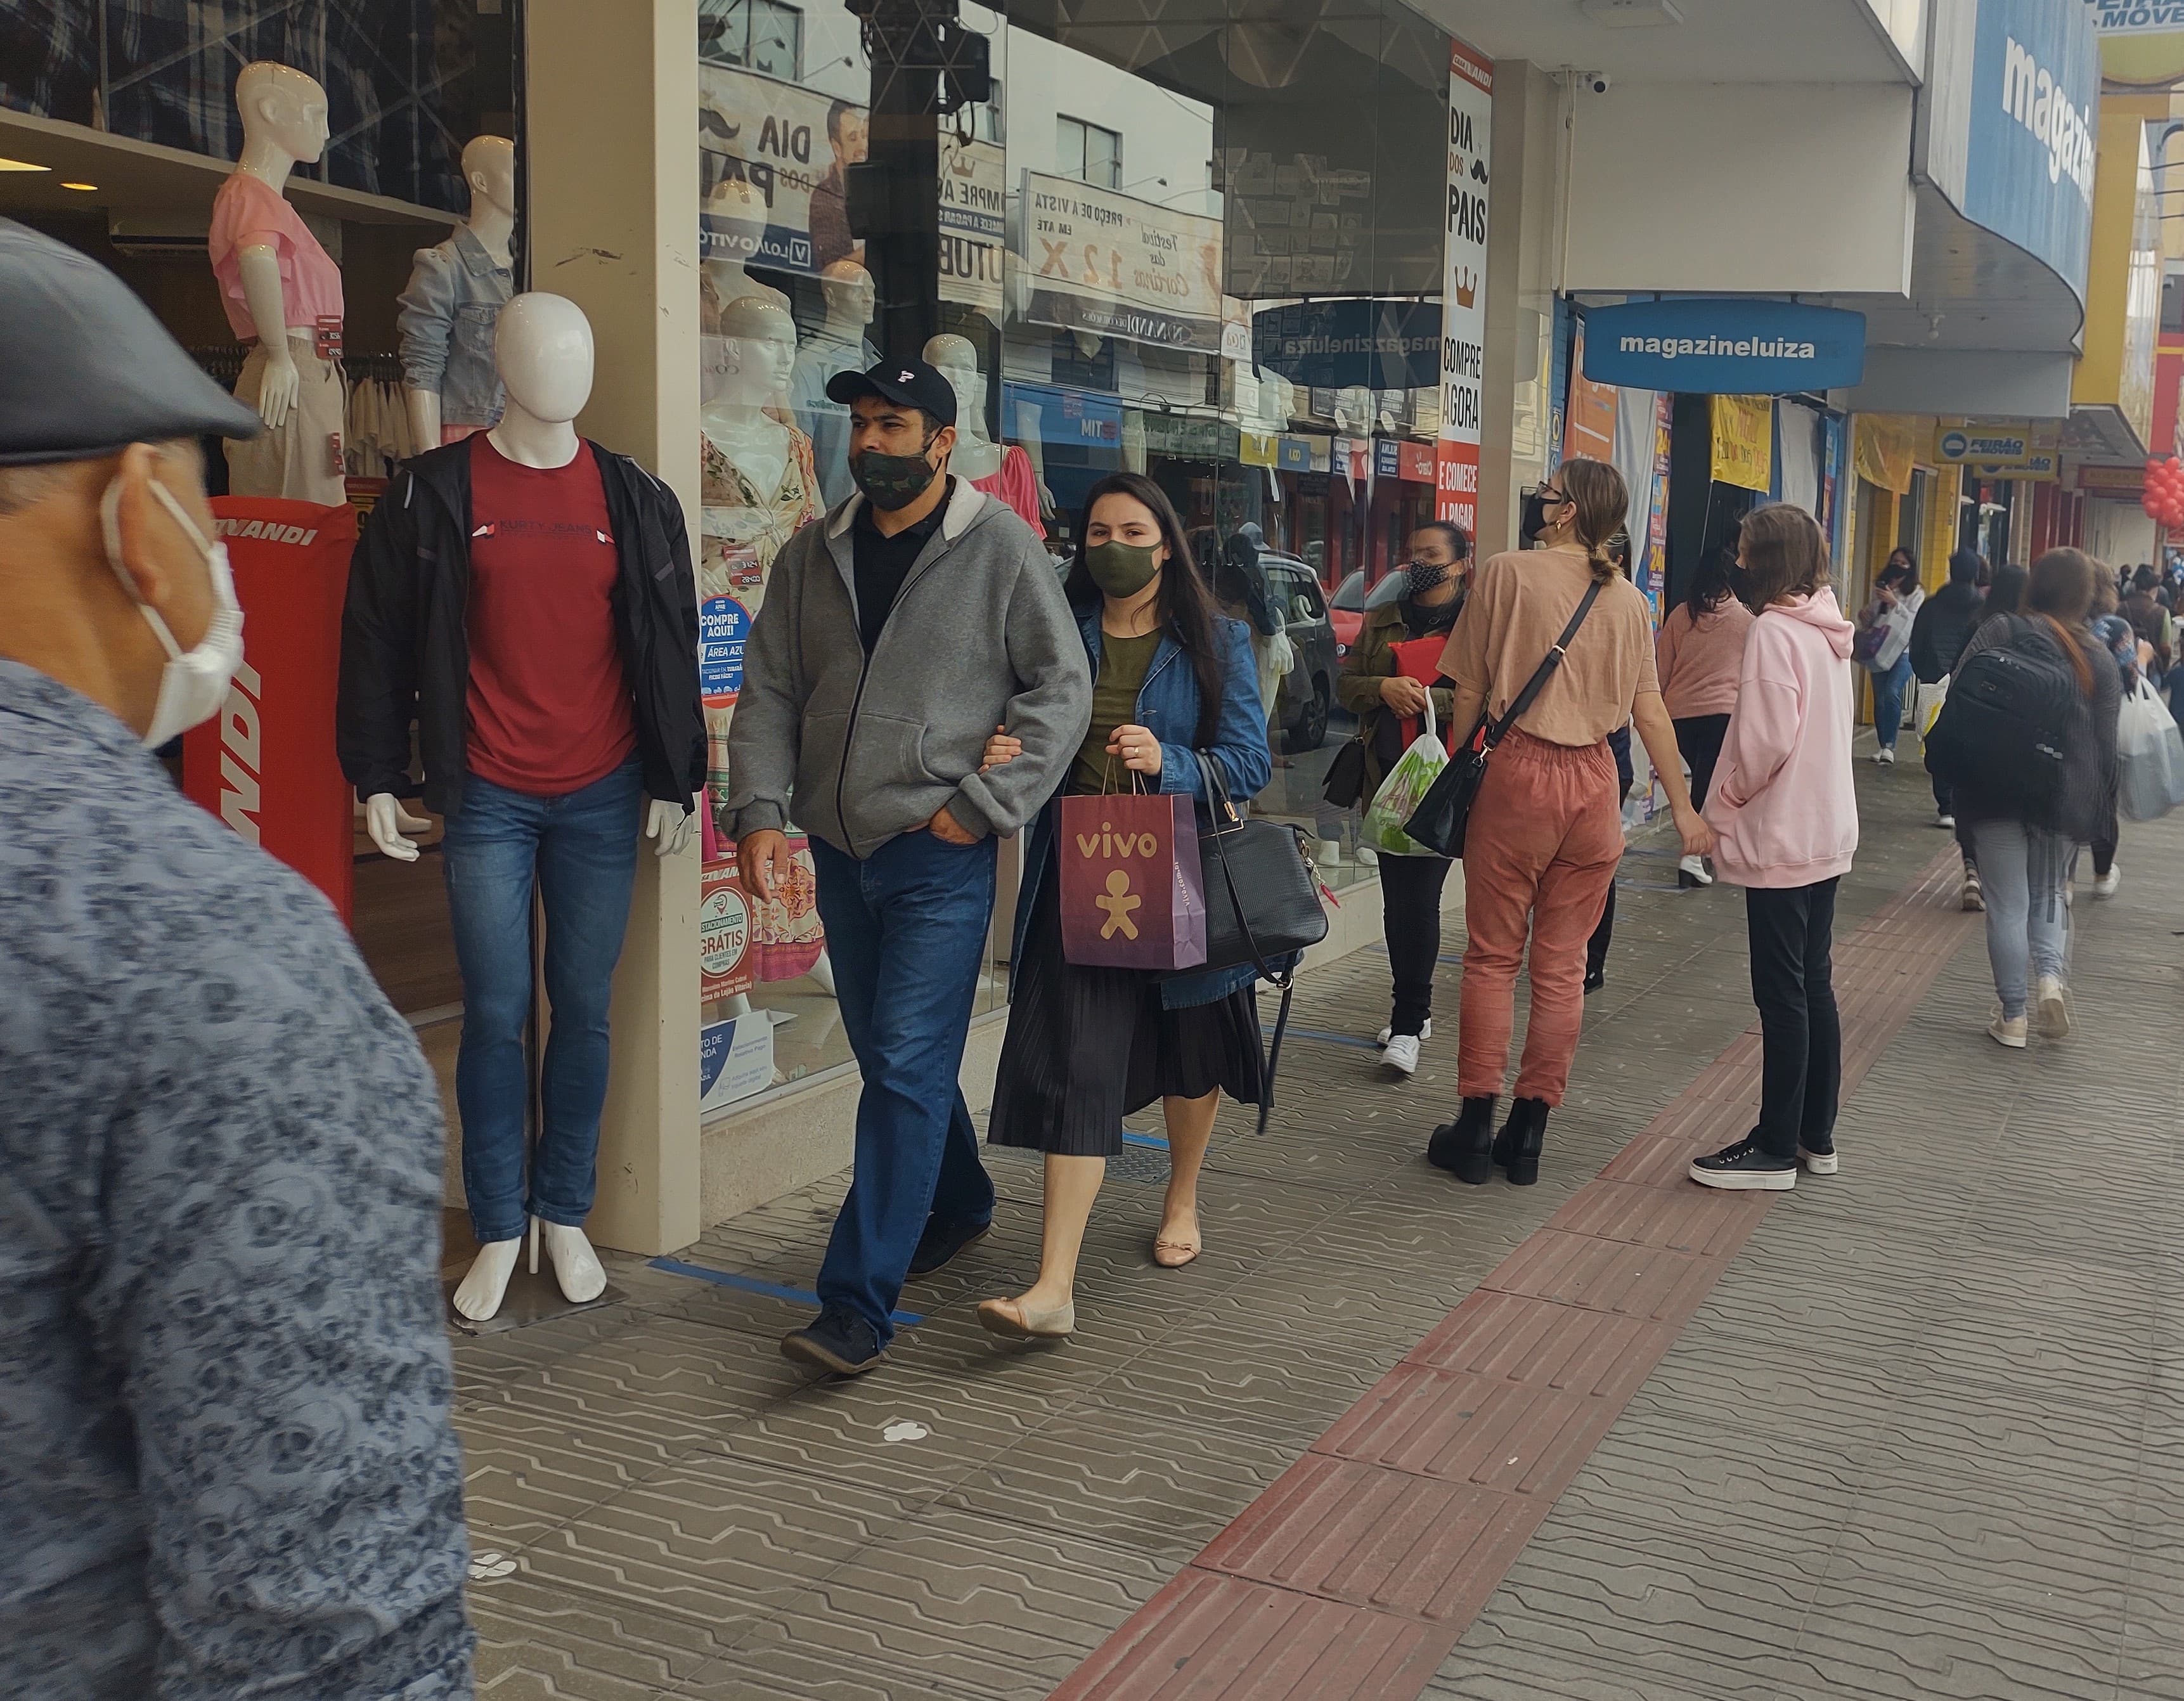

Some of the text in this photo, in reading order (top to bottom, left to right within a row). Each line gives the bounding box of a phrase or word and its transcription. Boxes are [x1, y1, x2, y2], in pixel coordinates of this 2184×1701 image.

[1451, 106, 1473, 153] DIA
[1449, 152, 1464, 177] DOS
[1448, 183, 1485, 245] PAIS
[1444, 336, 1482, 379] COMPRE
[1620, 335, 1815, 359] magazineluiza
[1442, 382, 1478, 430] AGORA
[1970, 437, 2024, 448] FEIRÃO
[1438, 461, 1478, 493] E COMECE
[701, 614, 739, 626] COMPRE
[708, 645, 728, 657] ÁREA
[1076, 821, 1158, 858] vivo
[701, 930, 743, 956] GRÁTIS
[711, 1034, 723, 1045] DE
